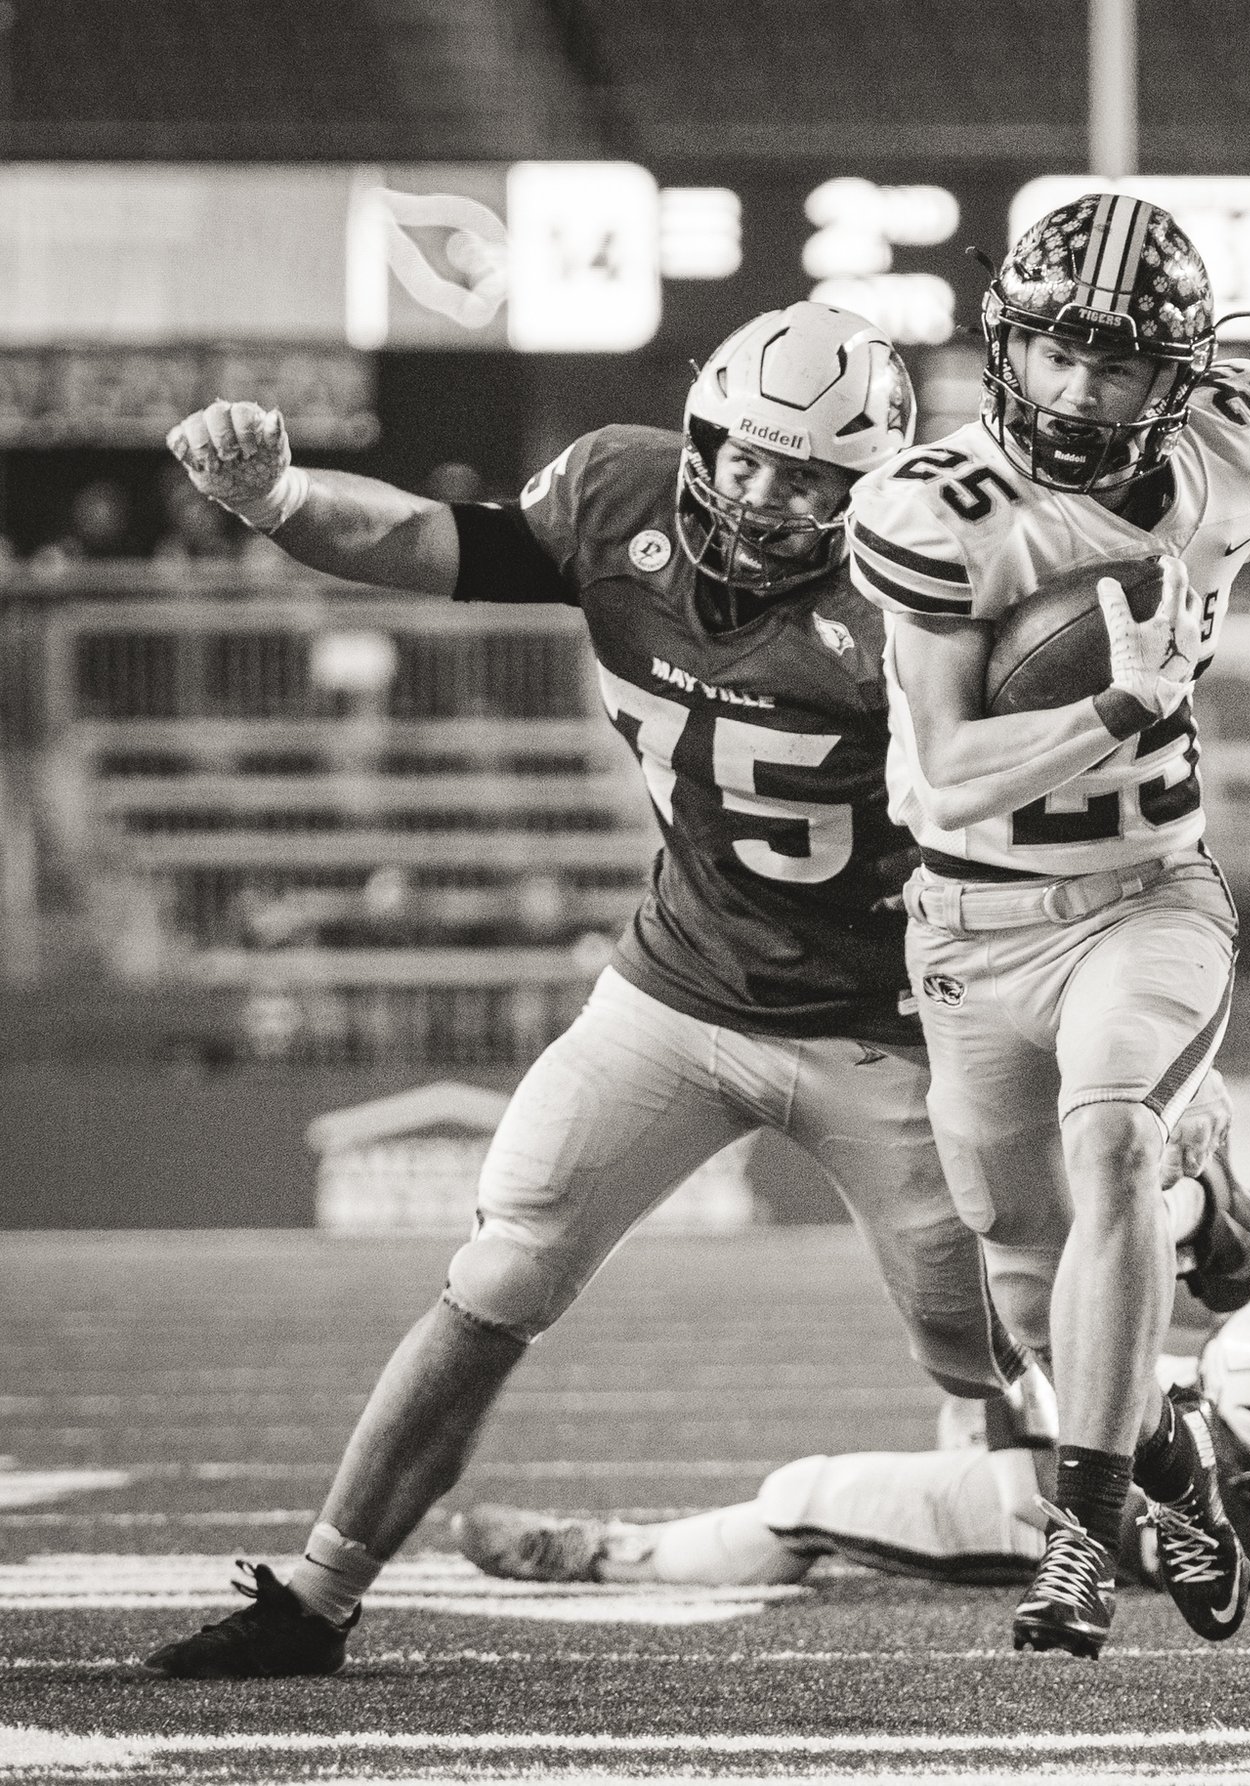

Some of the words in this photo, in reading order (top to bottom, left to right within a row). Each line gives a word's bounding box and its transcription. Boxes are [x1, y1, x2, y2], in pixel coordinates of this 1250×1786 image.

[1079, 307, 1122, 327] TIGERS
[739, 418, 804, 450] Riddell
[890, 447, 1021, 523] 25
[600, 661, 854, 884] 75
